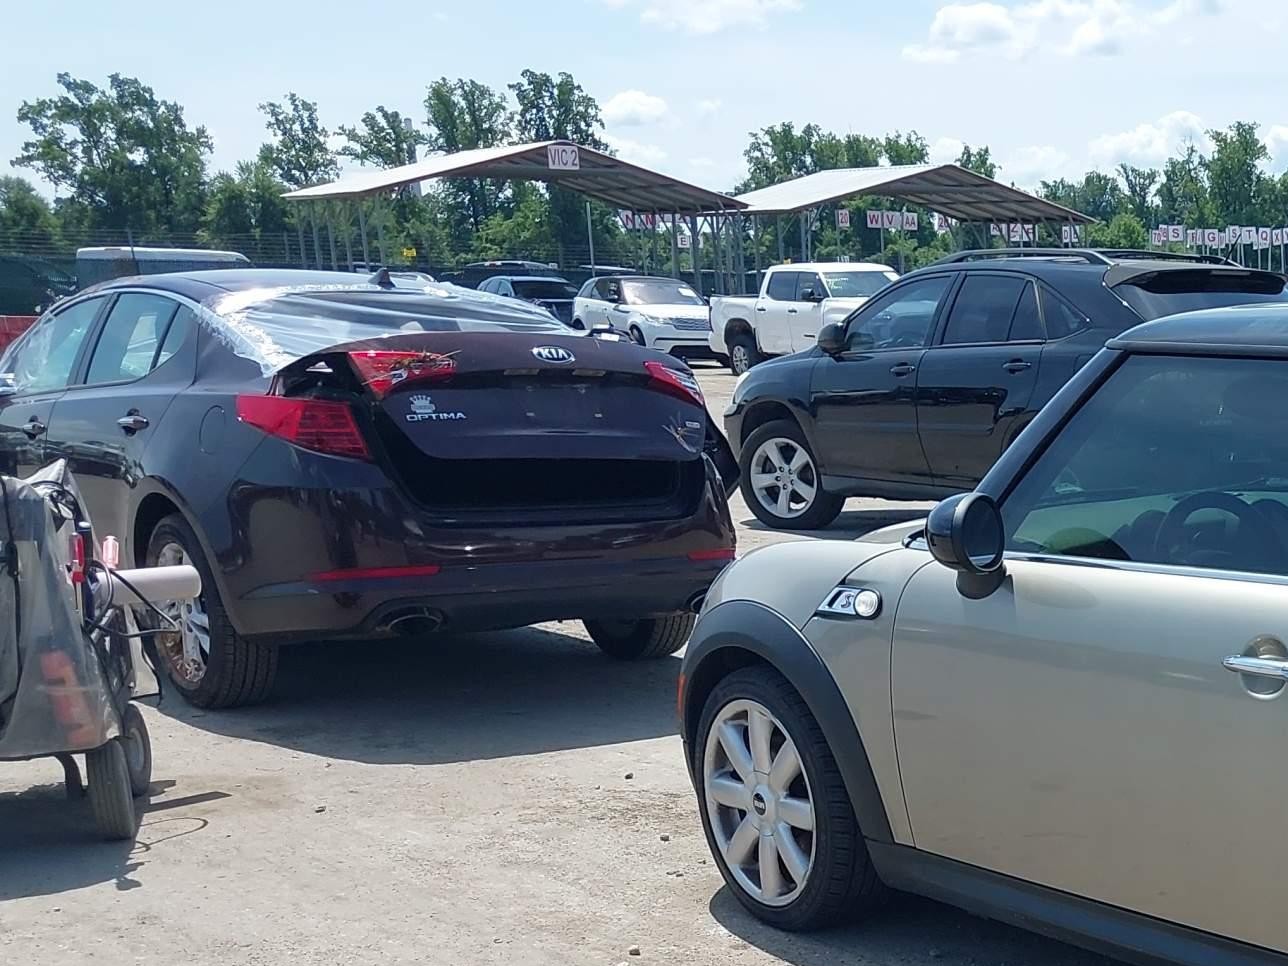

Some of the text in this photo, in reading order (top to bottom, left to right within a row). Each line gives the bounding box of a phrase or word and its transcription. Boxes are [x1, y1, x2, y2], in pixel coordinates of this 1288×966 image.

[549, 149, 578, 166] VIC 2
[869, 214, 880, 225] W
[885, 215, 894, 225] V
[905, 216, 916, 227] AA
[1172, 228, 1180, 238] S
[1207, 232, 1216, 242] G
[1246, 229, 1253, 239] T
[1261, 230, 1268, 241] Q
[1274, 232, 1280, 242] X
[537, 347, 570, 360] KIA
[406, 413, 467, 421] OPTIMA
[840, 593, 855, 608] S
